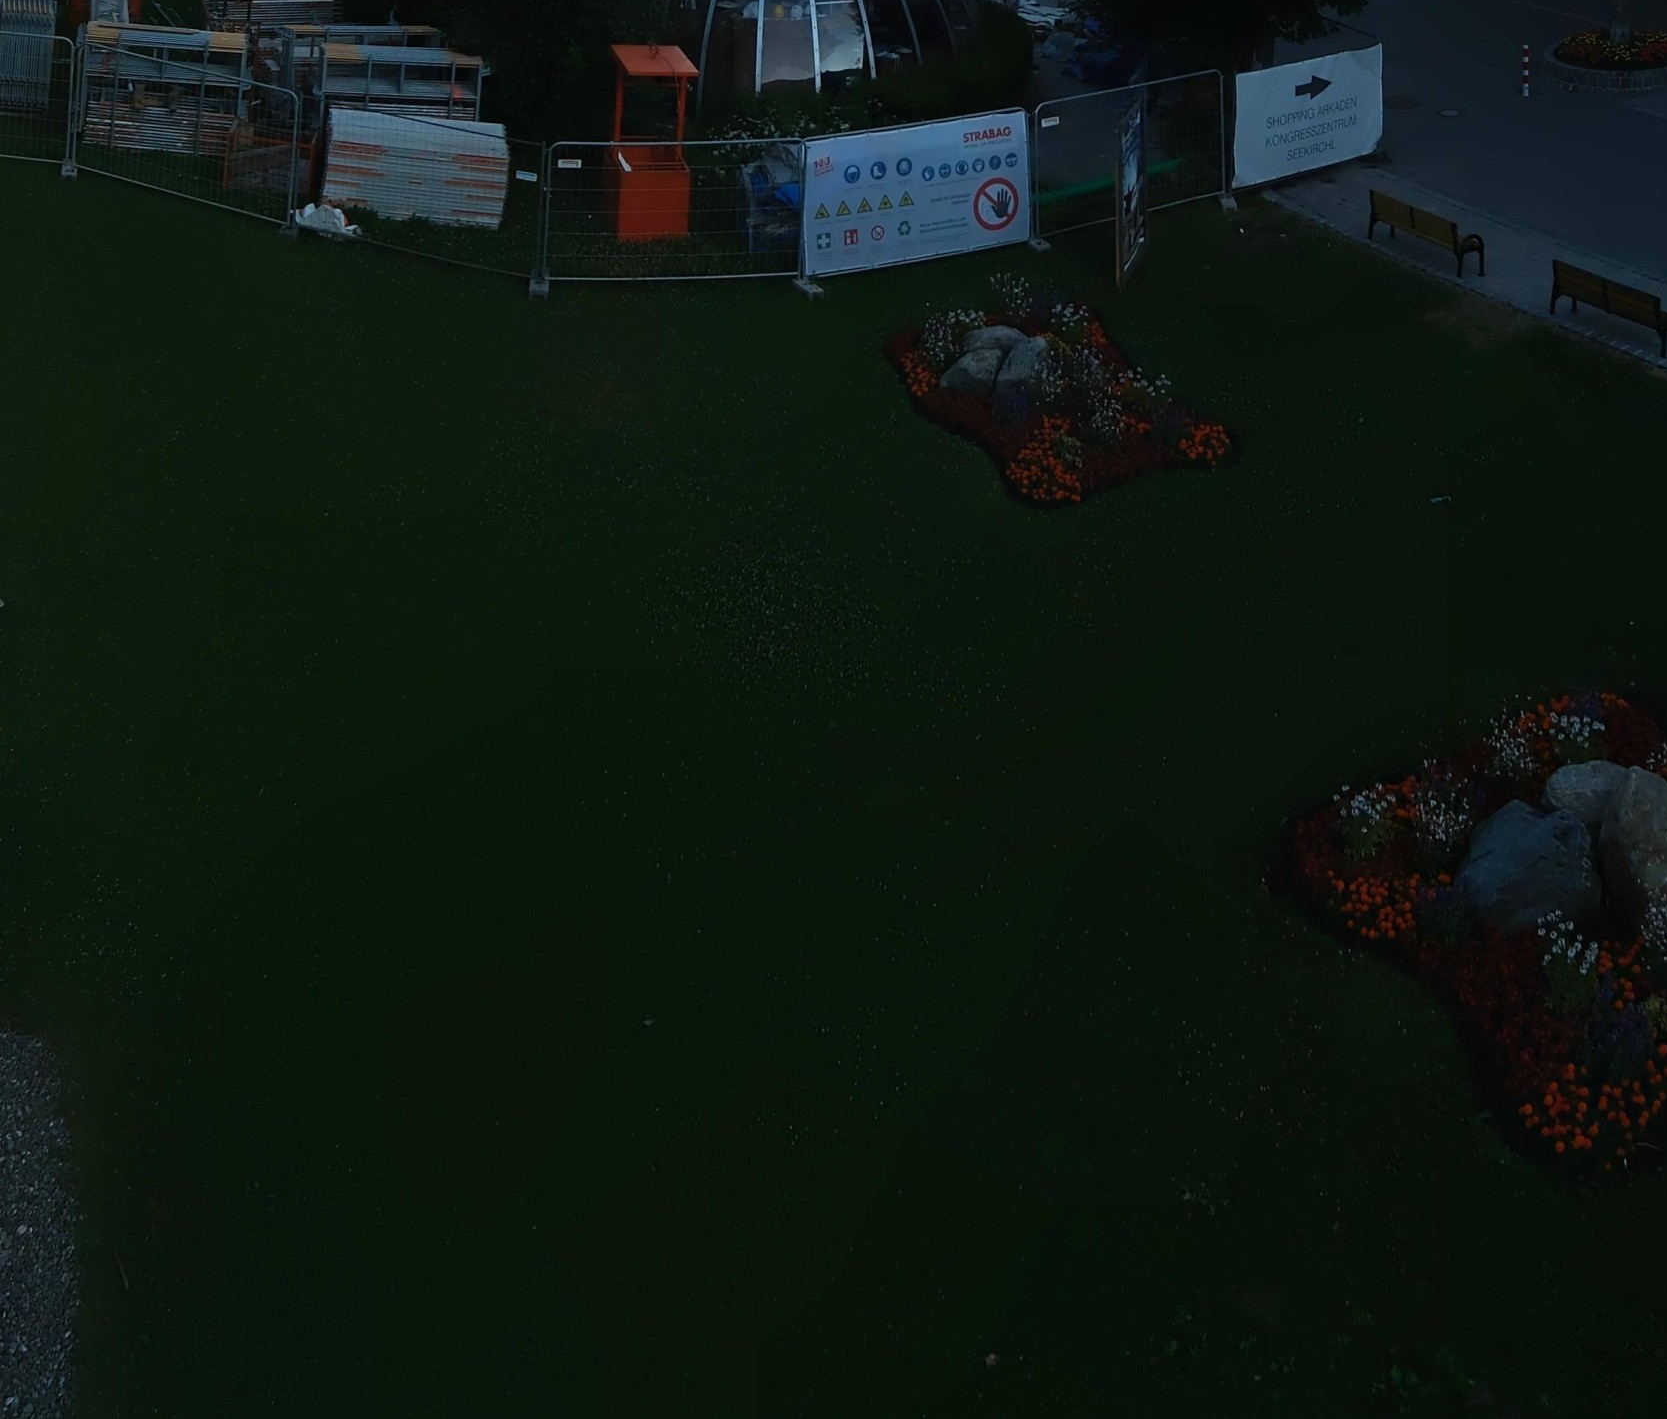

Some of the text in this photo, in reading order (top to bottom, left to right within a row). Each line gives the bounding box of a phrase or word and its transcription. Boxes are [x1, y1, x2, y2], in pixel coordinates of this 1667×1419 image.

[1266, 97, 1358, 129] SHOPPING ARKADEN
[963, 127, 1011, 143] STRABAG
[1265, 115, 1357, 148] KONGRESSZENTRUM
[1286, 139, 1336, 161] SEEKIRCHL
